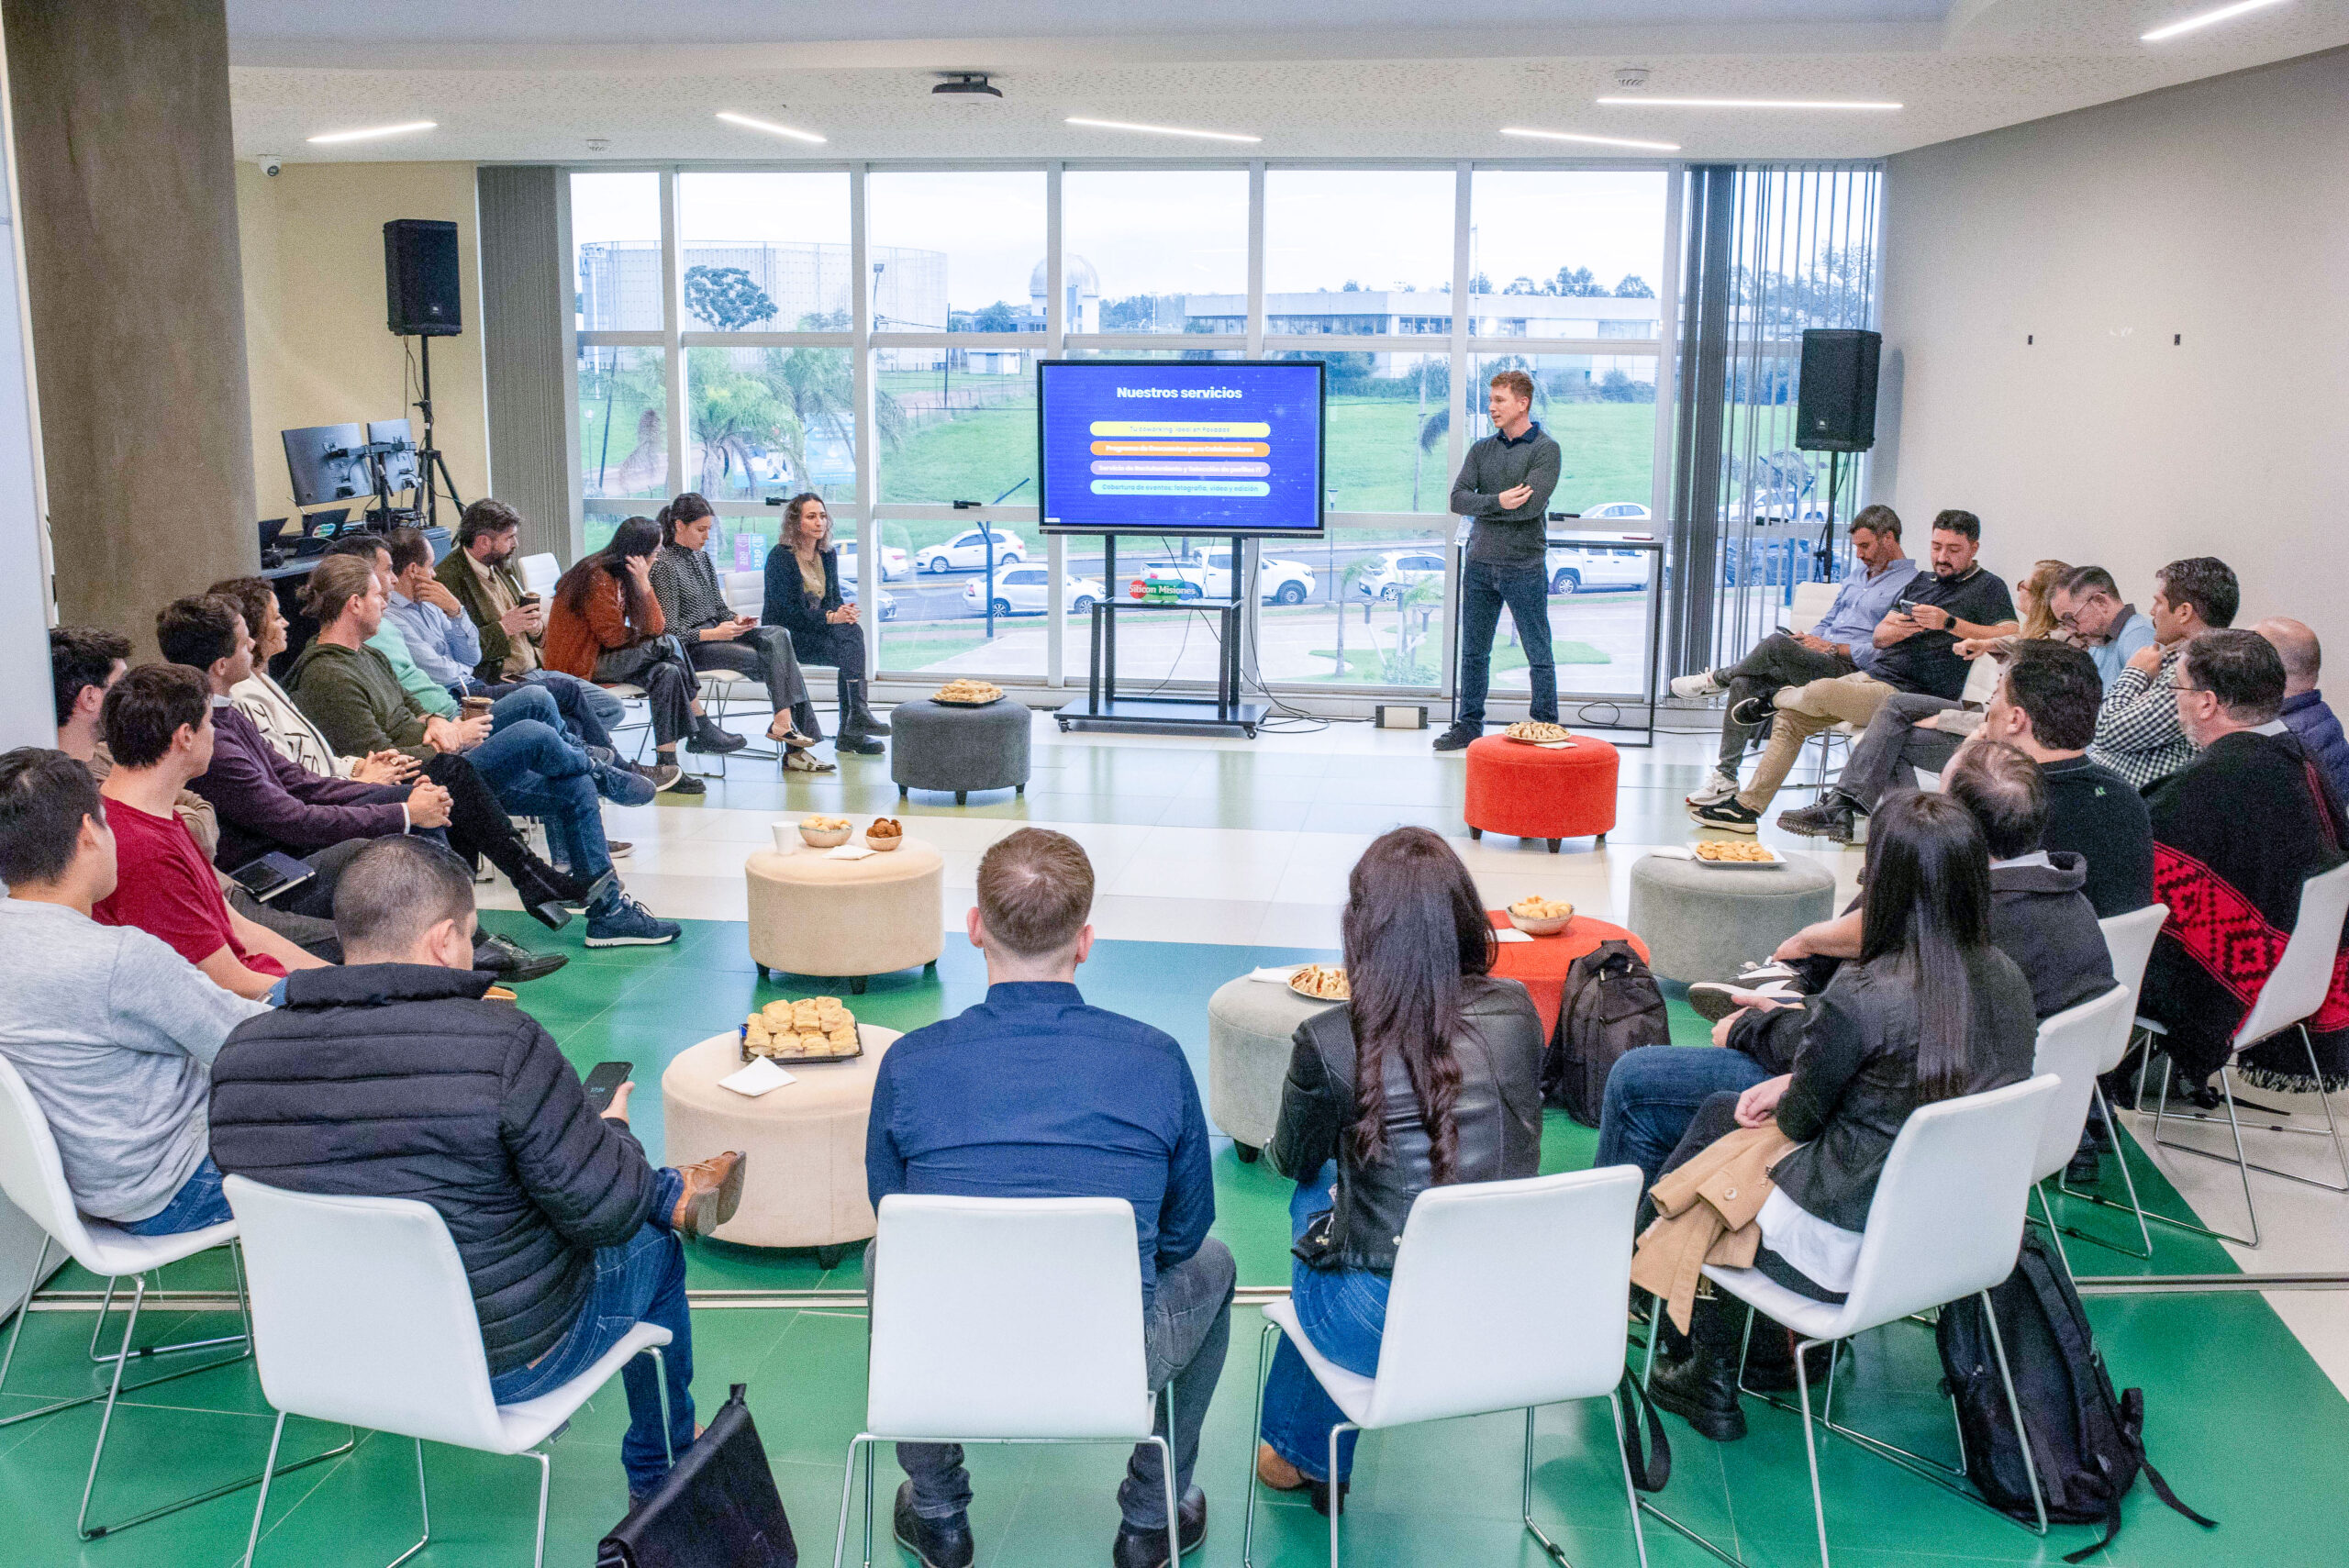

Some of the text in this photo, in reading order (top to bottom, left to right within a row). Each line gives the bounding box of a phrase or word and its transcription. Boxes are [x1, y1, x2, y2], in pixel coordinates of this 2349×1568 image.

[1116, 385, 1243, 399] Nuestros servicios
[1129, 584, 1196, 595] Silicon Misiones
